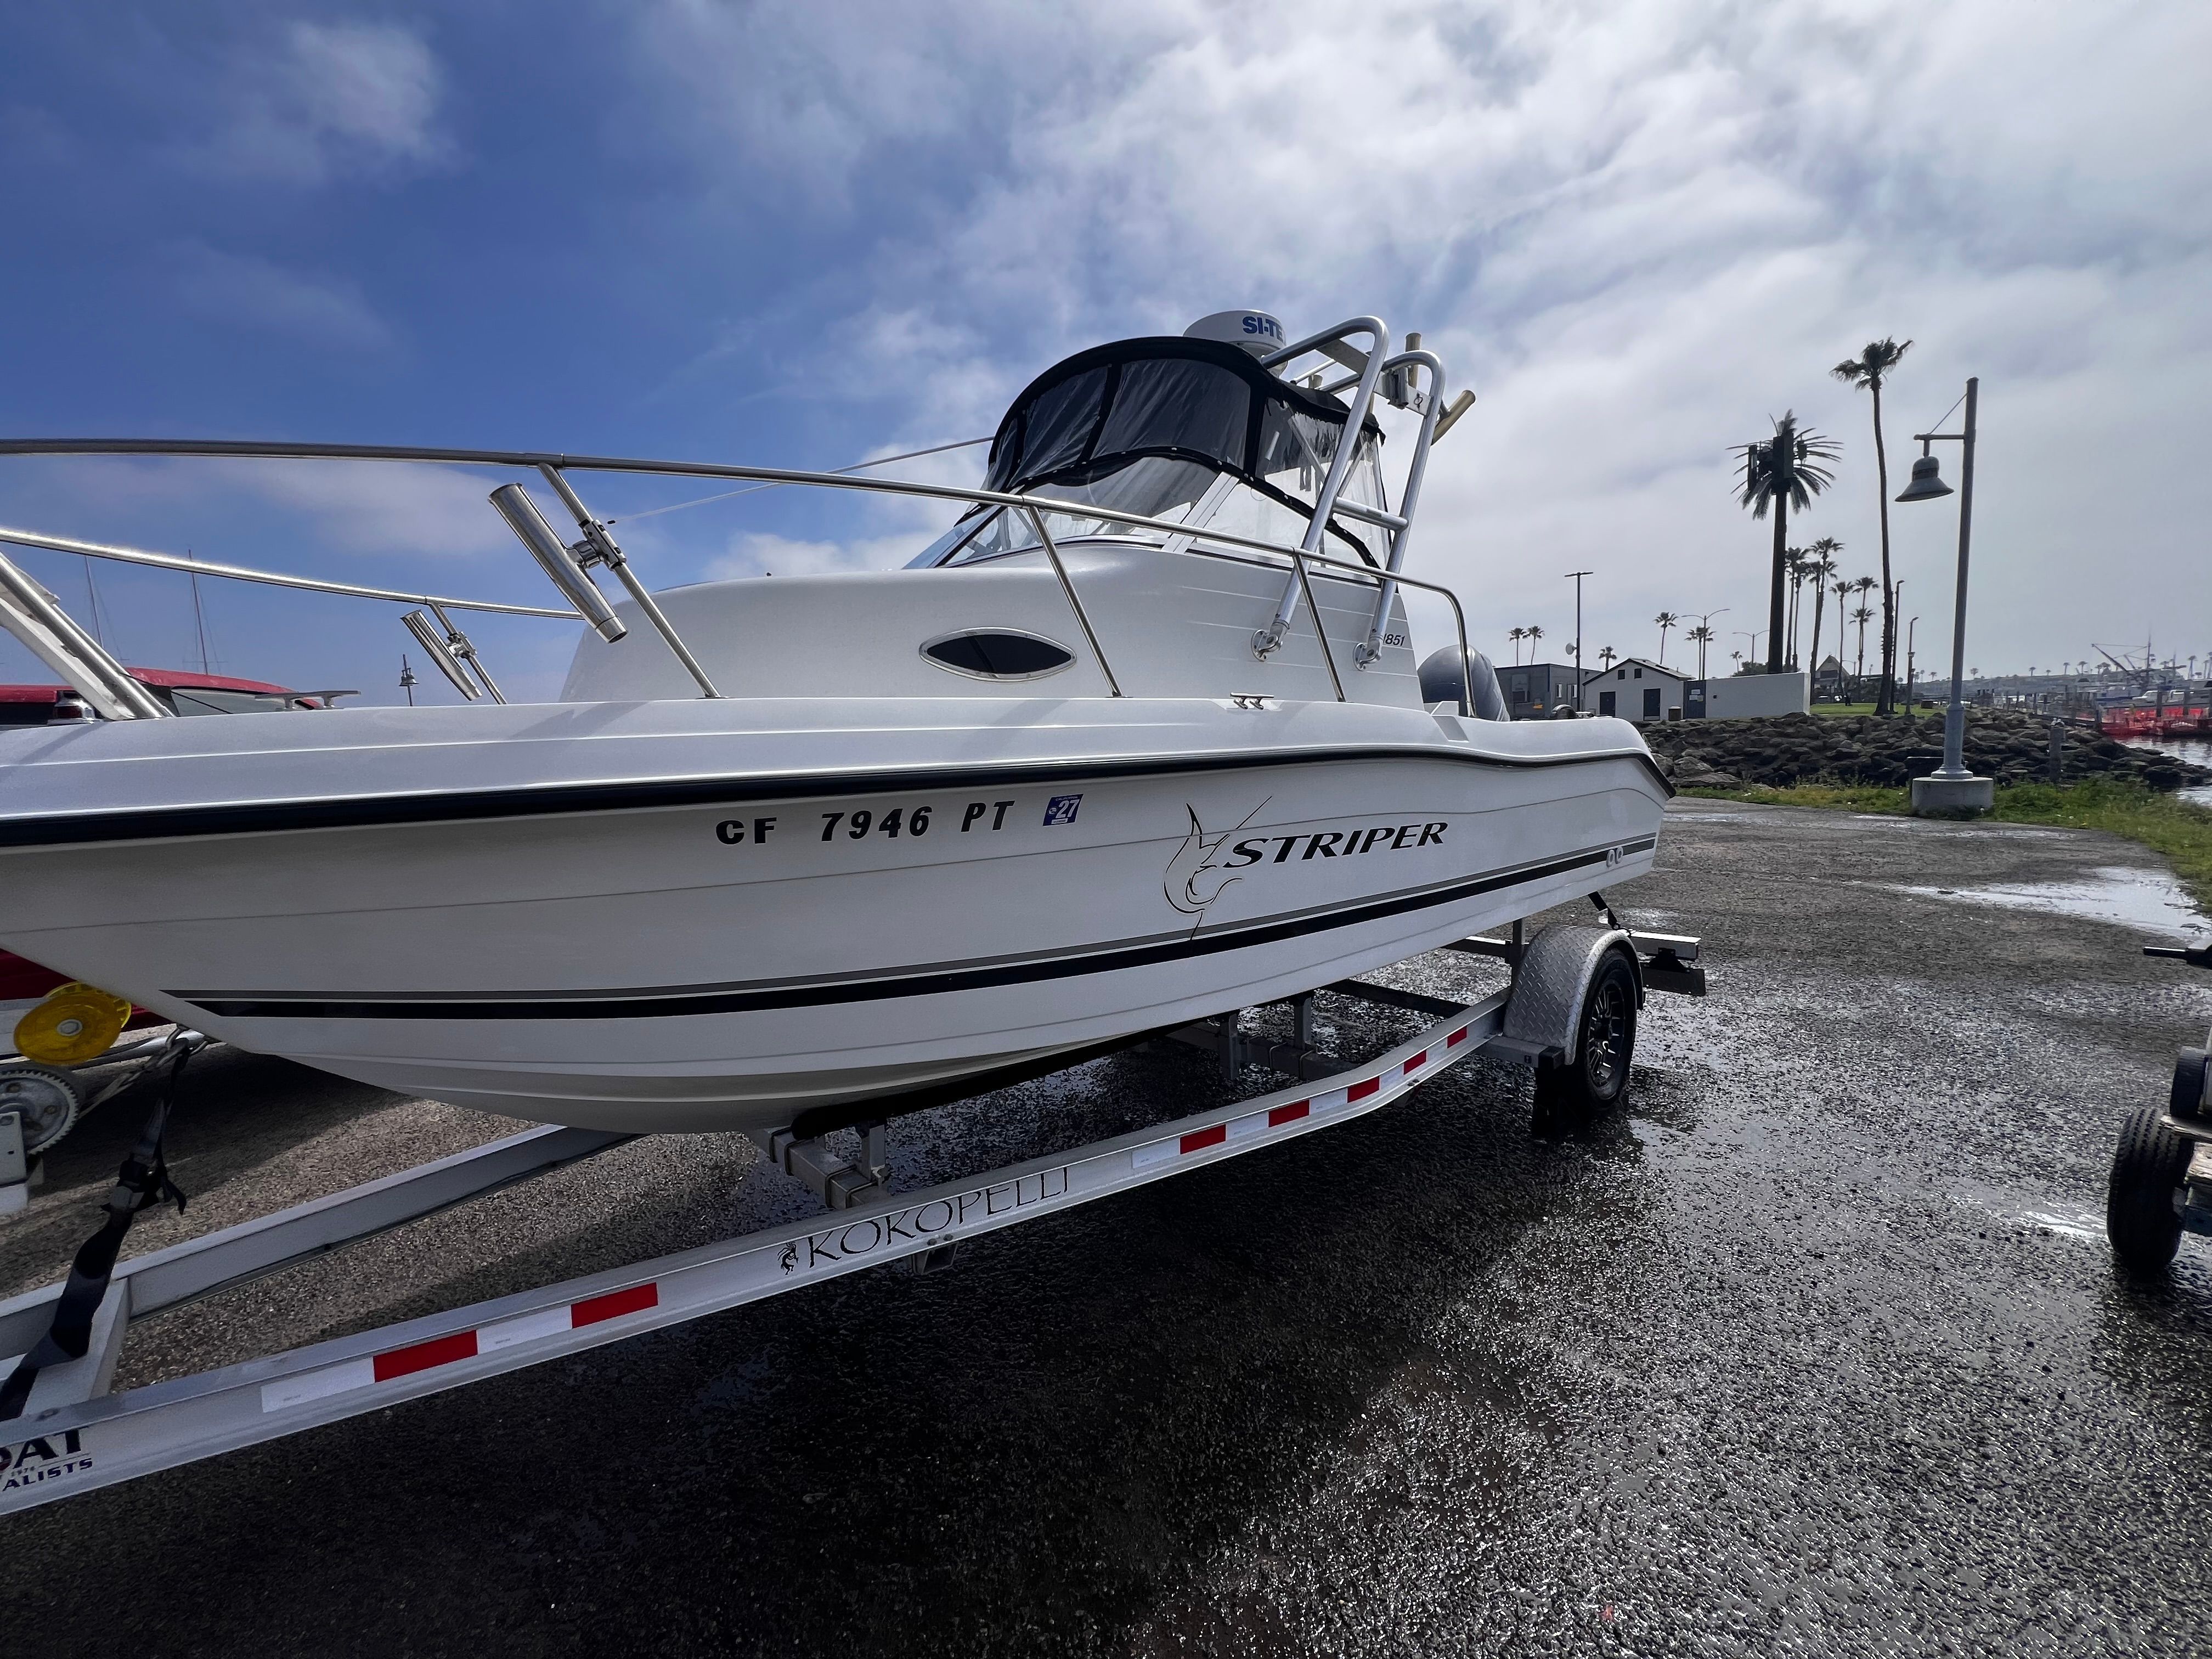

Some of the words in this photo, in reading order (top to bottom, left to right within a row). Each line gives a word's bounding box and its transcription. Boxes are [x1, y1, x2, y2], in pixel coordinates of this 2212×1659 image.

[716, 817, 777, 845] CF
[821, 806, 932, 842] 7946
[961, 800, 1015, 832] PT
[1055, 799, 1080, 819] 27
[1222, 822, 1448, 868] STRIPER
[808, 1167, 1068, 1268] KOKOPELLI
